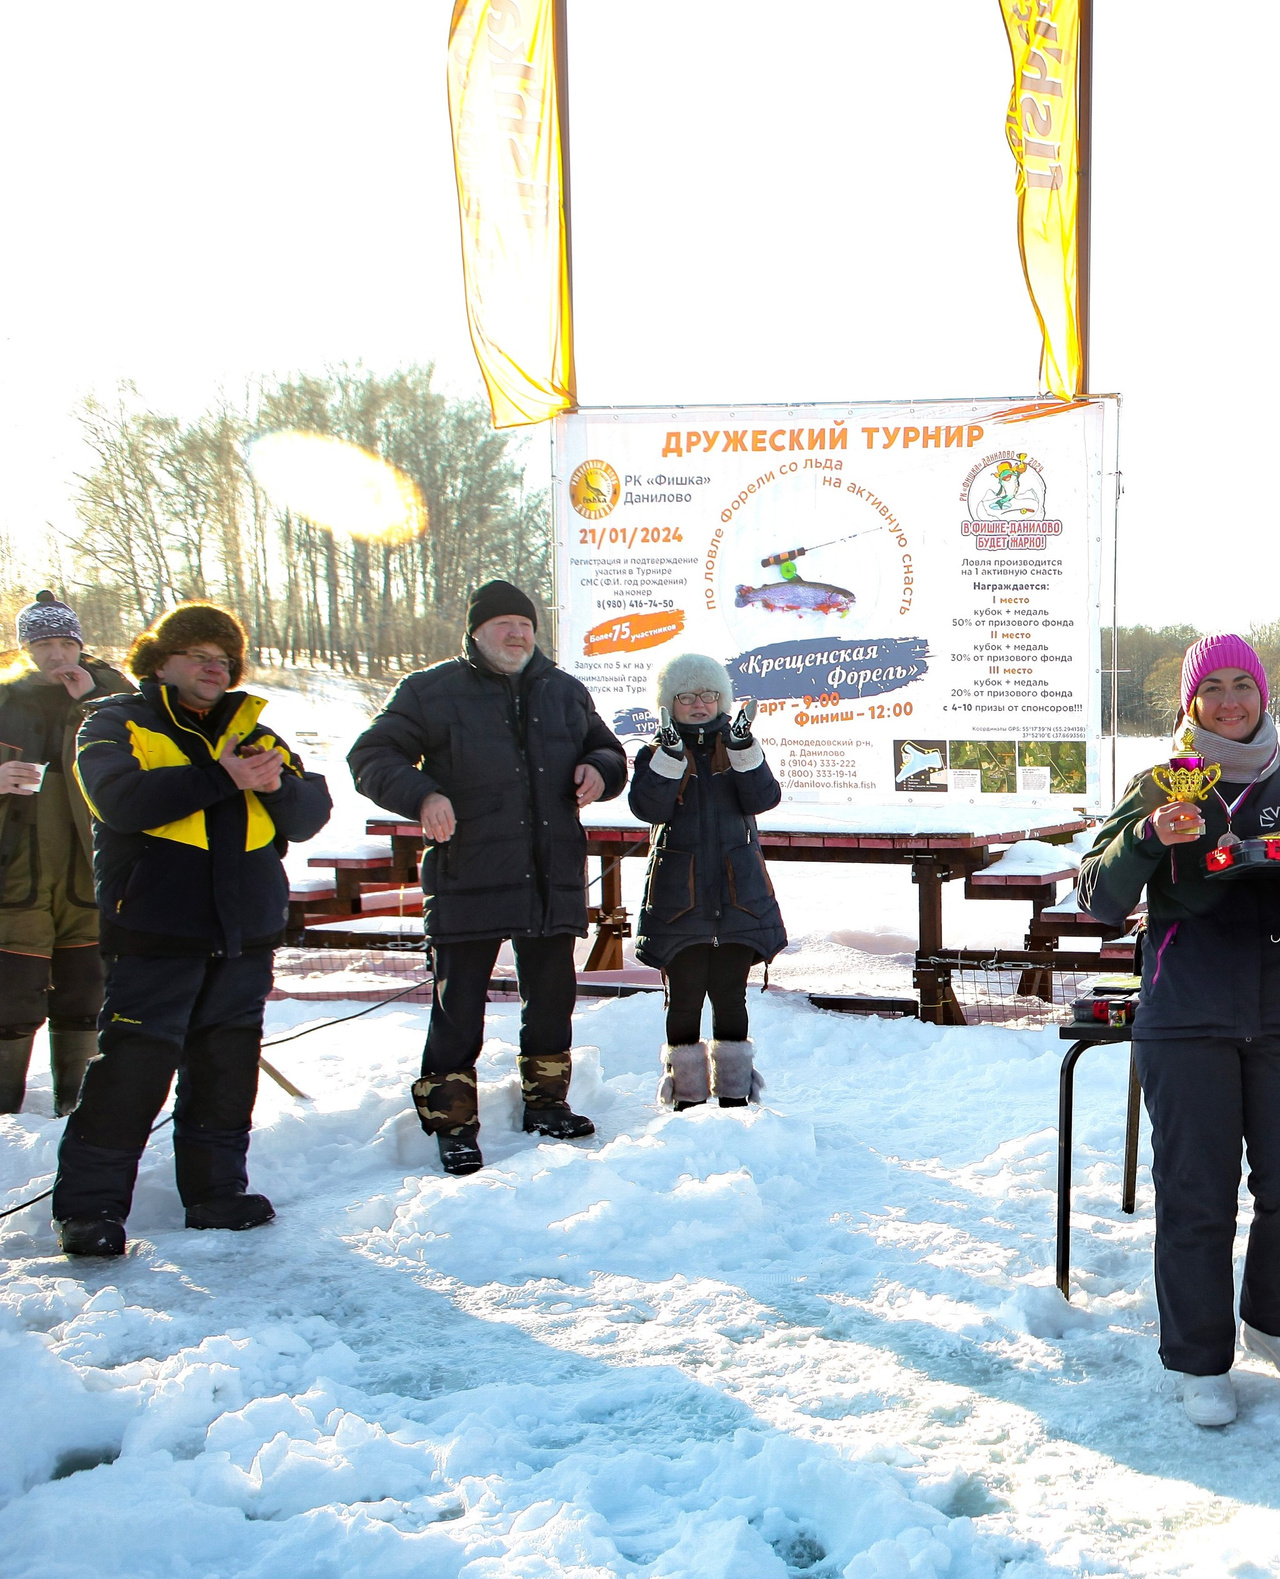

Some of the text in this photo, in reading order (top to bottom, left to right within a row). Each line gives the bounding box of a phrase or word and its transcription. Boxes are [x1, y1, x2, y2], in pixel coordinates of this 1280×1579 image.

[661, 420, 985, 458] ДРУЖЕСКИЙ ТУРНИР
[624, 475, 643, 487] РК
[647, 473, 711, 487] «Фишка»
[623, 491, 692, 506] Данилово
[704, 457, 843, 610] по ловле Форели со льда
[963, 522, 1060, 535] В ФИШКЕ-ДАНИЛОВО
[579, 527, 684, 550] 21/01/2024
[978, 536, 1045, 549] БУДЕТ ЖАРКО!
[822, 475, 914, 616] на активную снасть
[570, 558, 621, 566] Регистрация
[631, 557, 699, 566] подтверждение
[961, 558, 1063, 568] Ловля производится
[594, 569, 628, 577] участия
[636, 567, 672, 576] Турнире
[981, 569, 1028, 577] активную
[640, 578, 688, 587] рождения)
[973, 582, 1050, 593] Награждается:
[629, 600, 674, 608] 416-74-50
[973, 608, 1003, 617] кубок
[1013, 609, 1049, 617] медаль
[952, 619, 973, 627] 50%
[988, 620, 1039, 628] призового
[1041, 619, 1074, 628] фонда
[590, 622, 677, 643] Более 75 участников
[973, 643, 1003, 652] кубок
[1013, 644, 1049, 652] медаль
[738, 645, 879, 678] «Крещенская
[950, 654, 971, 662] 30%
[987, 655, 1038, 663] призового
[1040, 654, 1073, 663] фонда
[574, 661, 602, 670] Запуск
[1003, 667, 1033, 675] место
[827, 664, 919, 690] Форель»
[973, 679, 1003, 688] кубок
[1013, 680, 1049, 688] медаль
[626, 685, 647, 694] Турн
[951, 689, 971, 697] 20%
[987, 690, 1038, 698] призового
[1040, 689, 1073, 698] фонда
[741, 700, 786, 716] Сарт
[803, 692, 840, 710] 9:00
[951, 703, 973, 712] 4-10
[975, 705, 1005, 713] призы
[1021, 704, 1083, 713] спонсоров!!!
[632, 711, 651, 722] пар
[794, 710, 854, 727] Финиш
[868, 701, 914, 720] 12:00
[635, 721, 660, 732] турн
[761, 738, 874, 749] МО, Домодедовский р-н,
[790, 749, 846, 758] д. Данилово
[780, 759, 856, 768] 8 (9104) 333-222
[788, 770, 814, 778] (800)
[816, 770, 857, 778] 333-19-14
[780, 780, 877, 789] s://danilovo.fishka.fish
